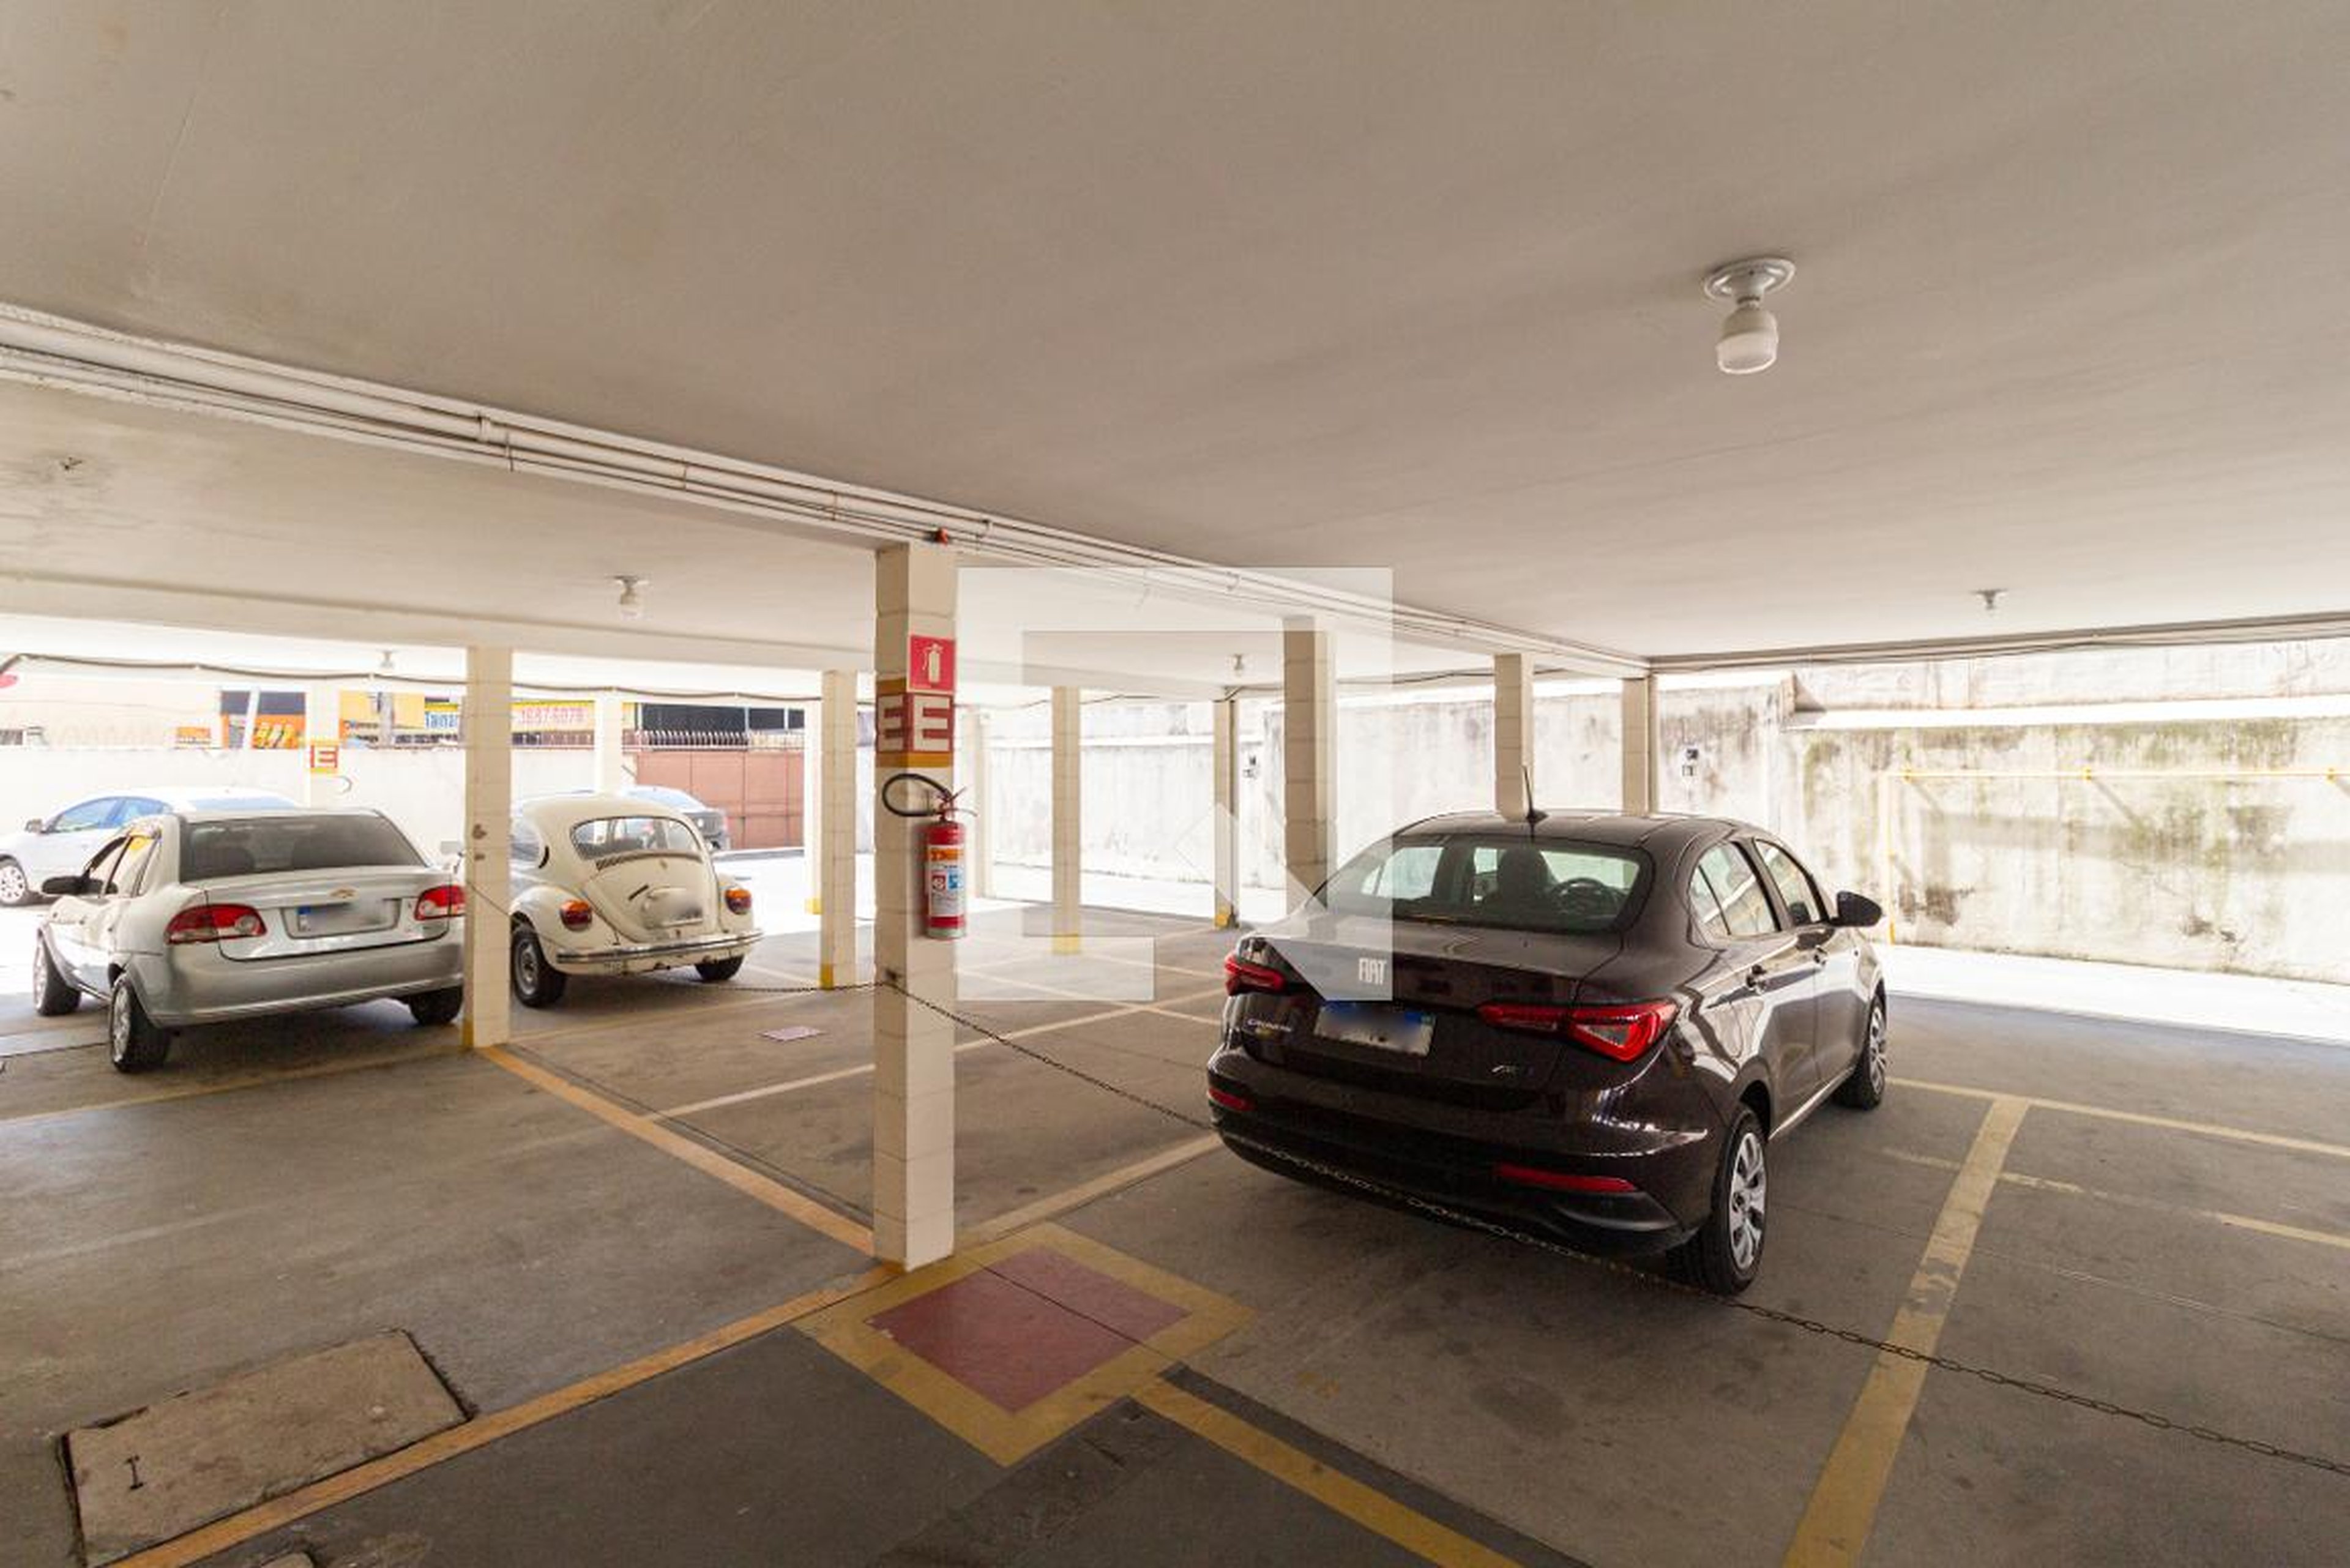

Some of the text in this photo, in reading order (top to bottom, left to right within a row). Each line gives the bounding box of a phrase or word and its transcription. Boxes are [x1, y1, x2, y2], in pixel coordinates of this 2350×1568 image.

[878, 695, 903, 751] E
[913, 695, 949, 752] E
[1358, 957, 1387, 985] FIAT
